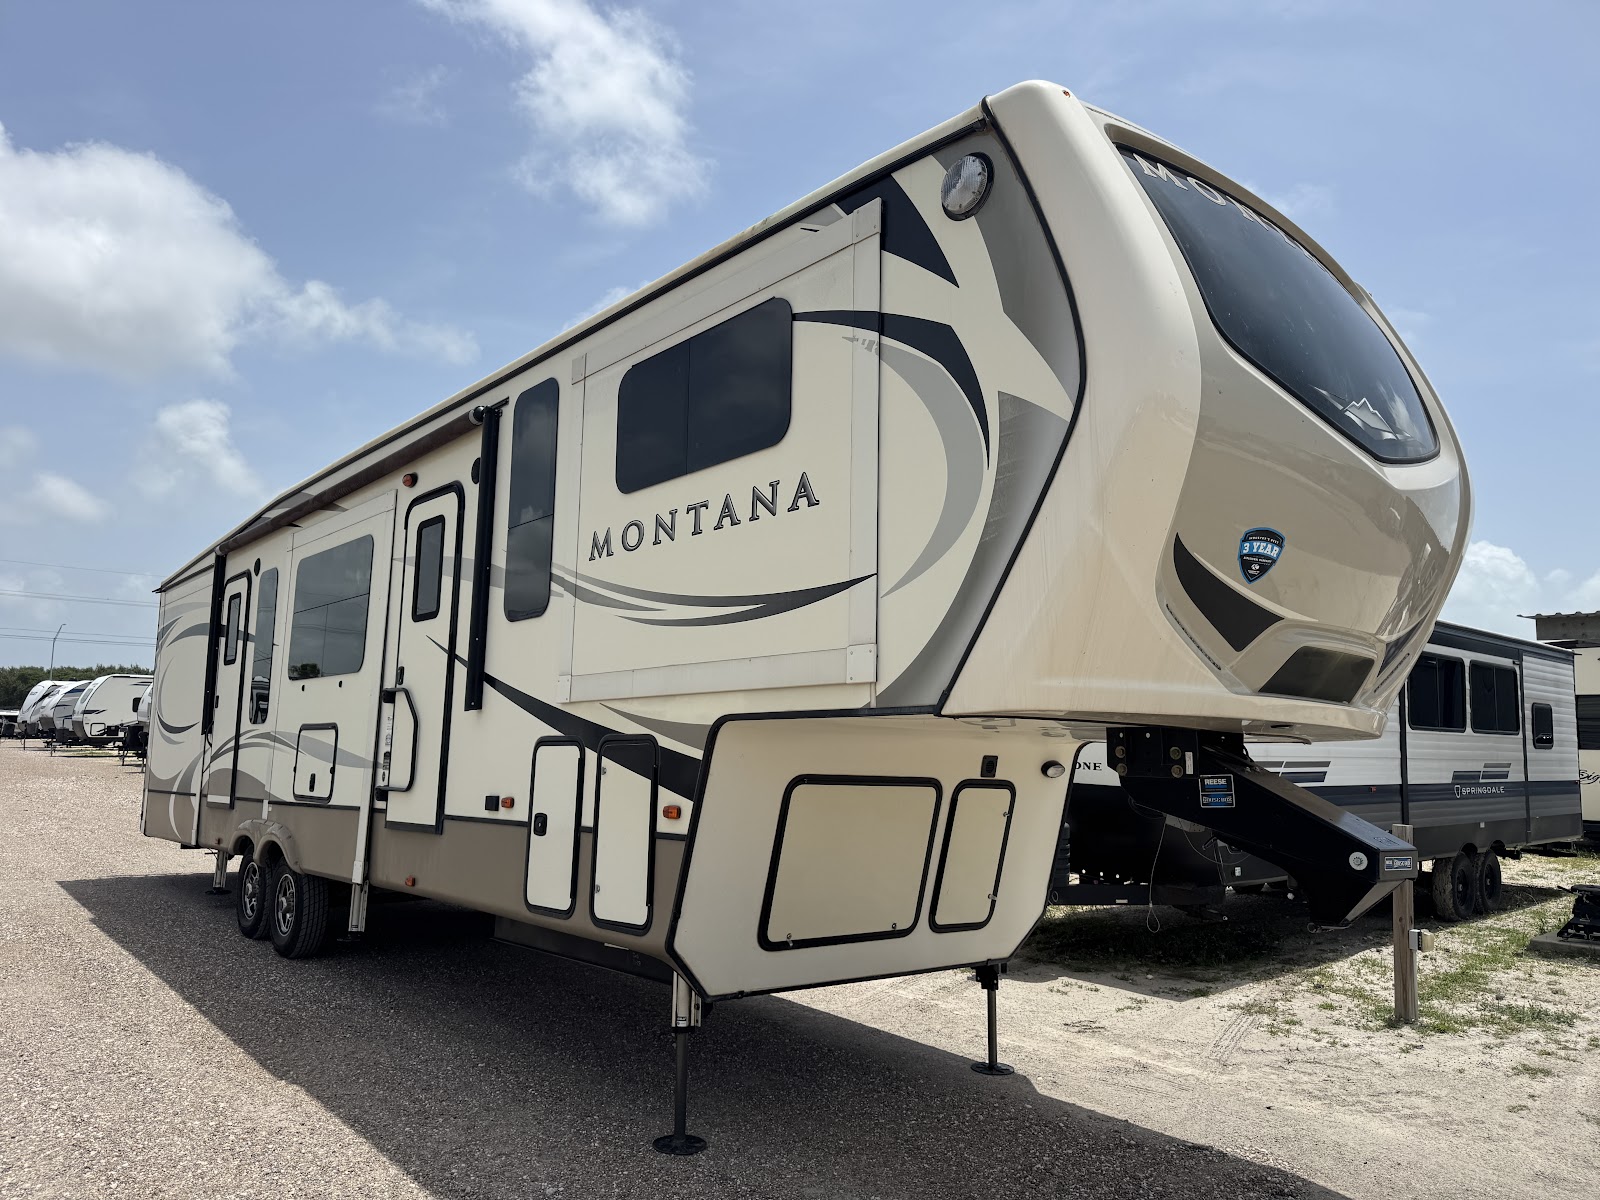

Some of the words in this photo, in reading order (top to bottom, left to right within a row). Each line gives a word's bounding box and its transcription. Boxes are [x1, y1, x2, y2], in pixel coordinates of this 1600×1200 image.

[589, 471, 820, 561] MONTANA
[1243, 542, 1250, 553] 3
[1253, 542, 1279, 557] YEAR
[1204, 778, 1228, 786] REESE
[1462, 786, 1505, 795] SPRINGDALE
